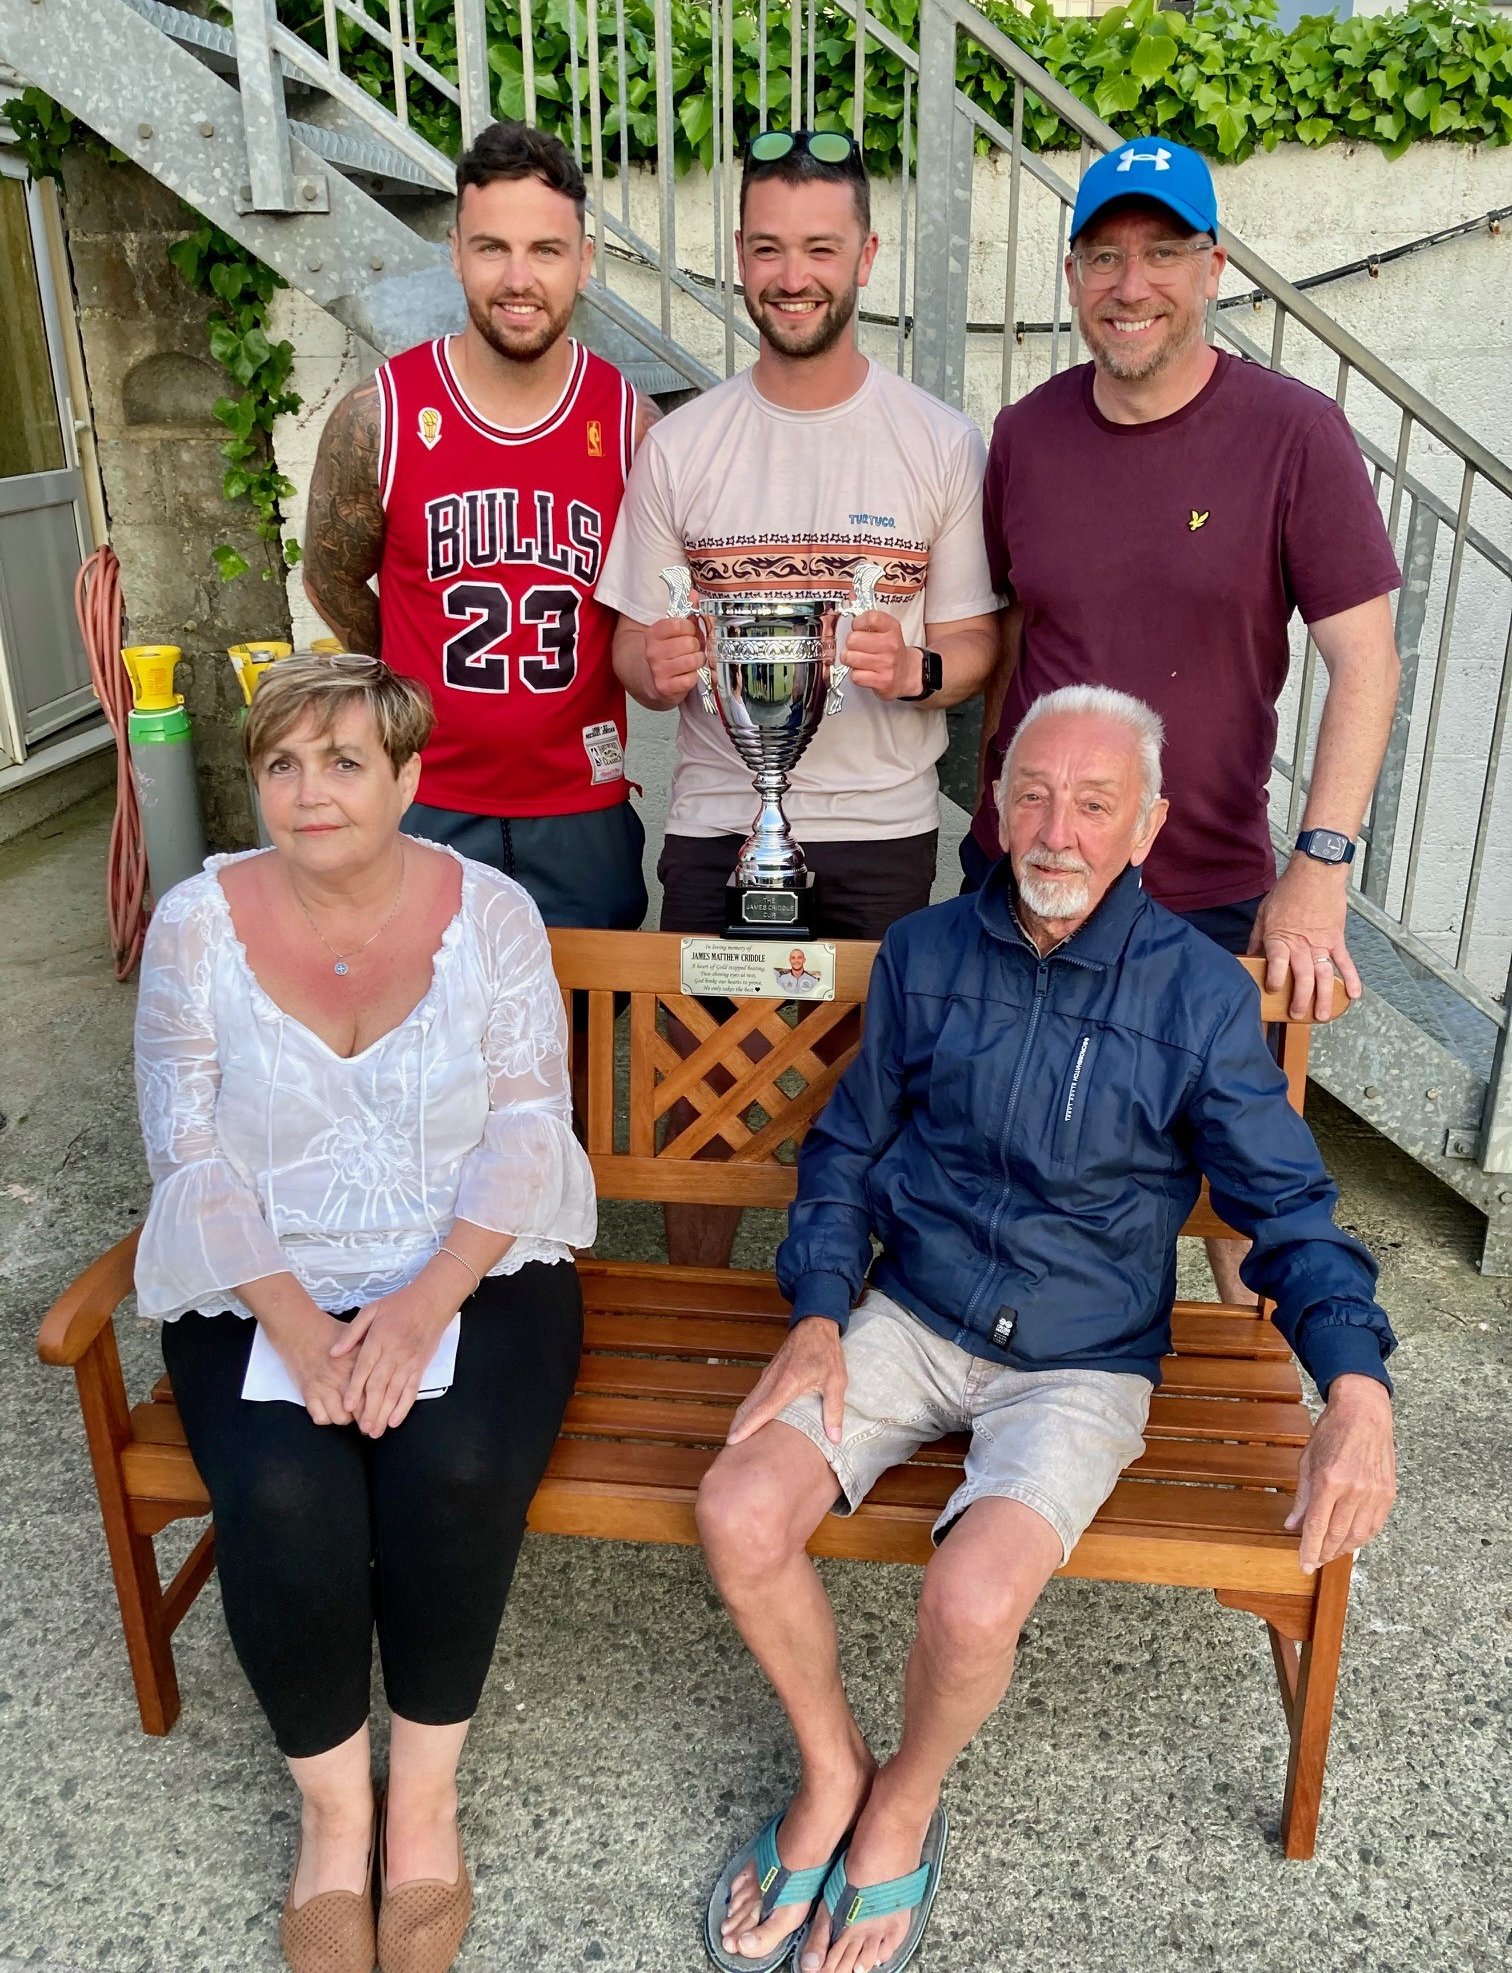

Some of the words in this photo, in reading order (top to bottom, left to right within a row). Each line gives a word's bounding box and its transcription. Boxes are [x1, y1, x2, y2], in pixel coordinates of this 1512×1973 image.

[425, 488, 602, 587] BULLS
[442, 581, 583, 694] 23
[691, 952, 710, 960] JAMES
[711, 953, 739, 961] MATTHEW
[741, 954, 765, 962] CRIDDLE
[716, 963, 728, 971] Gold
[728, 965, 747, 973] stopped
